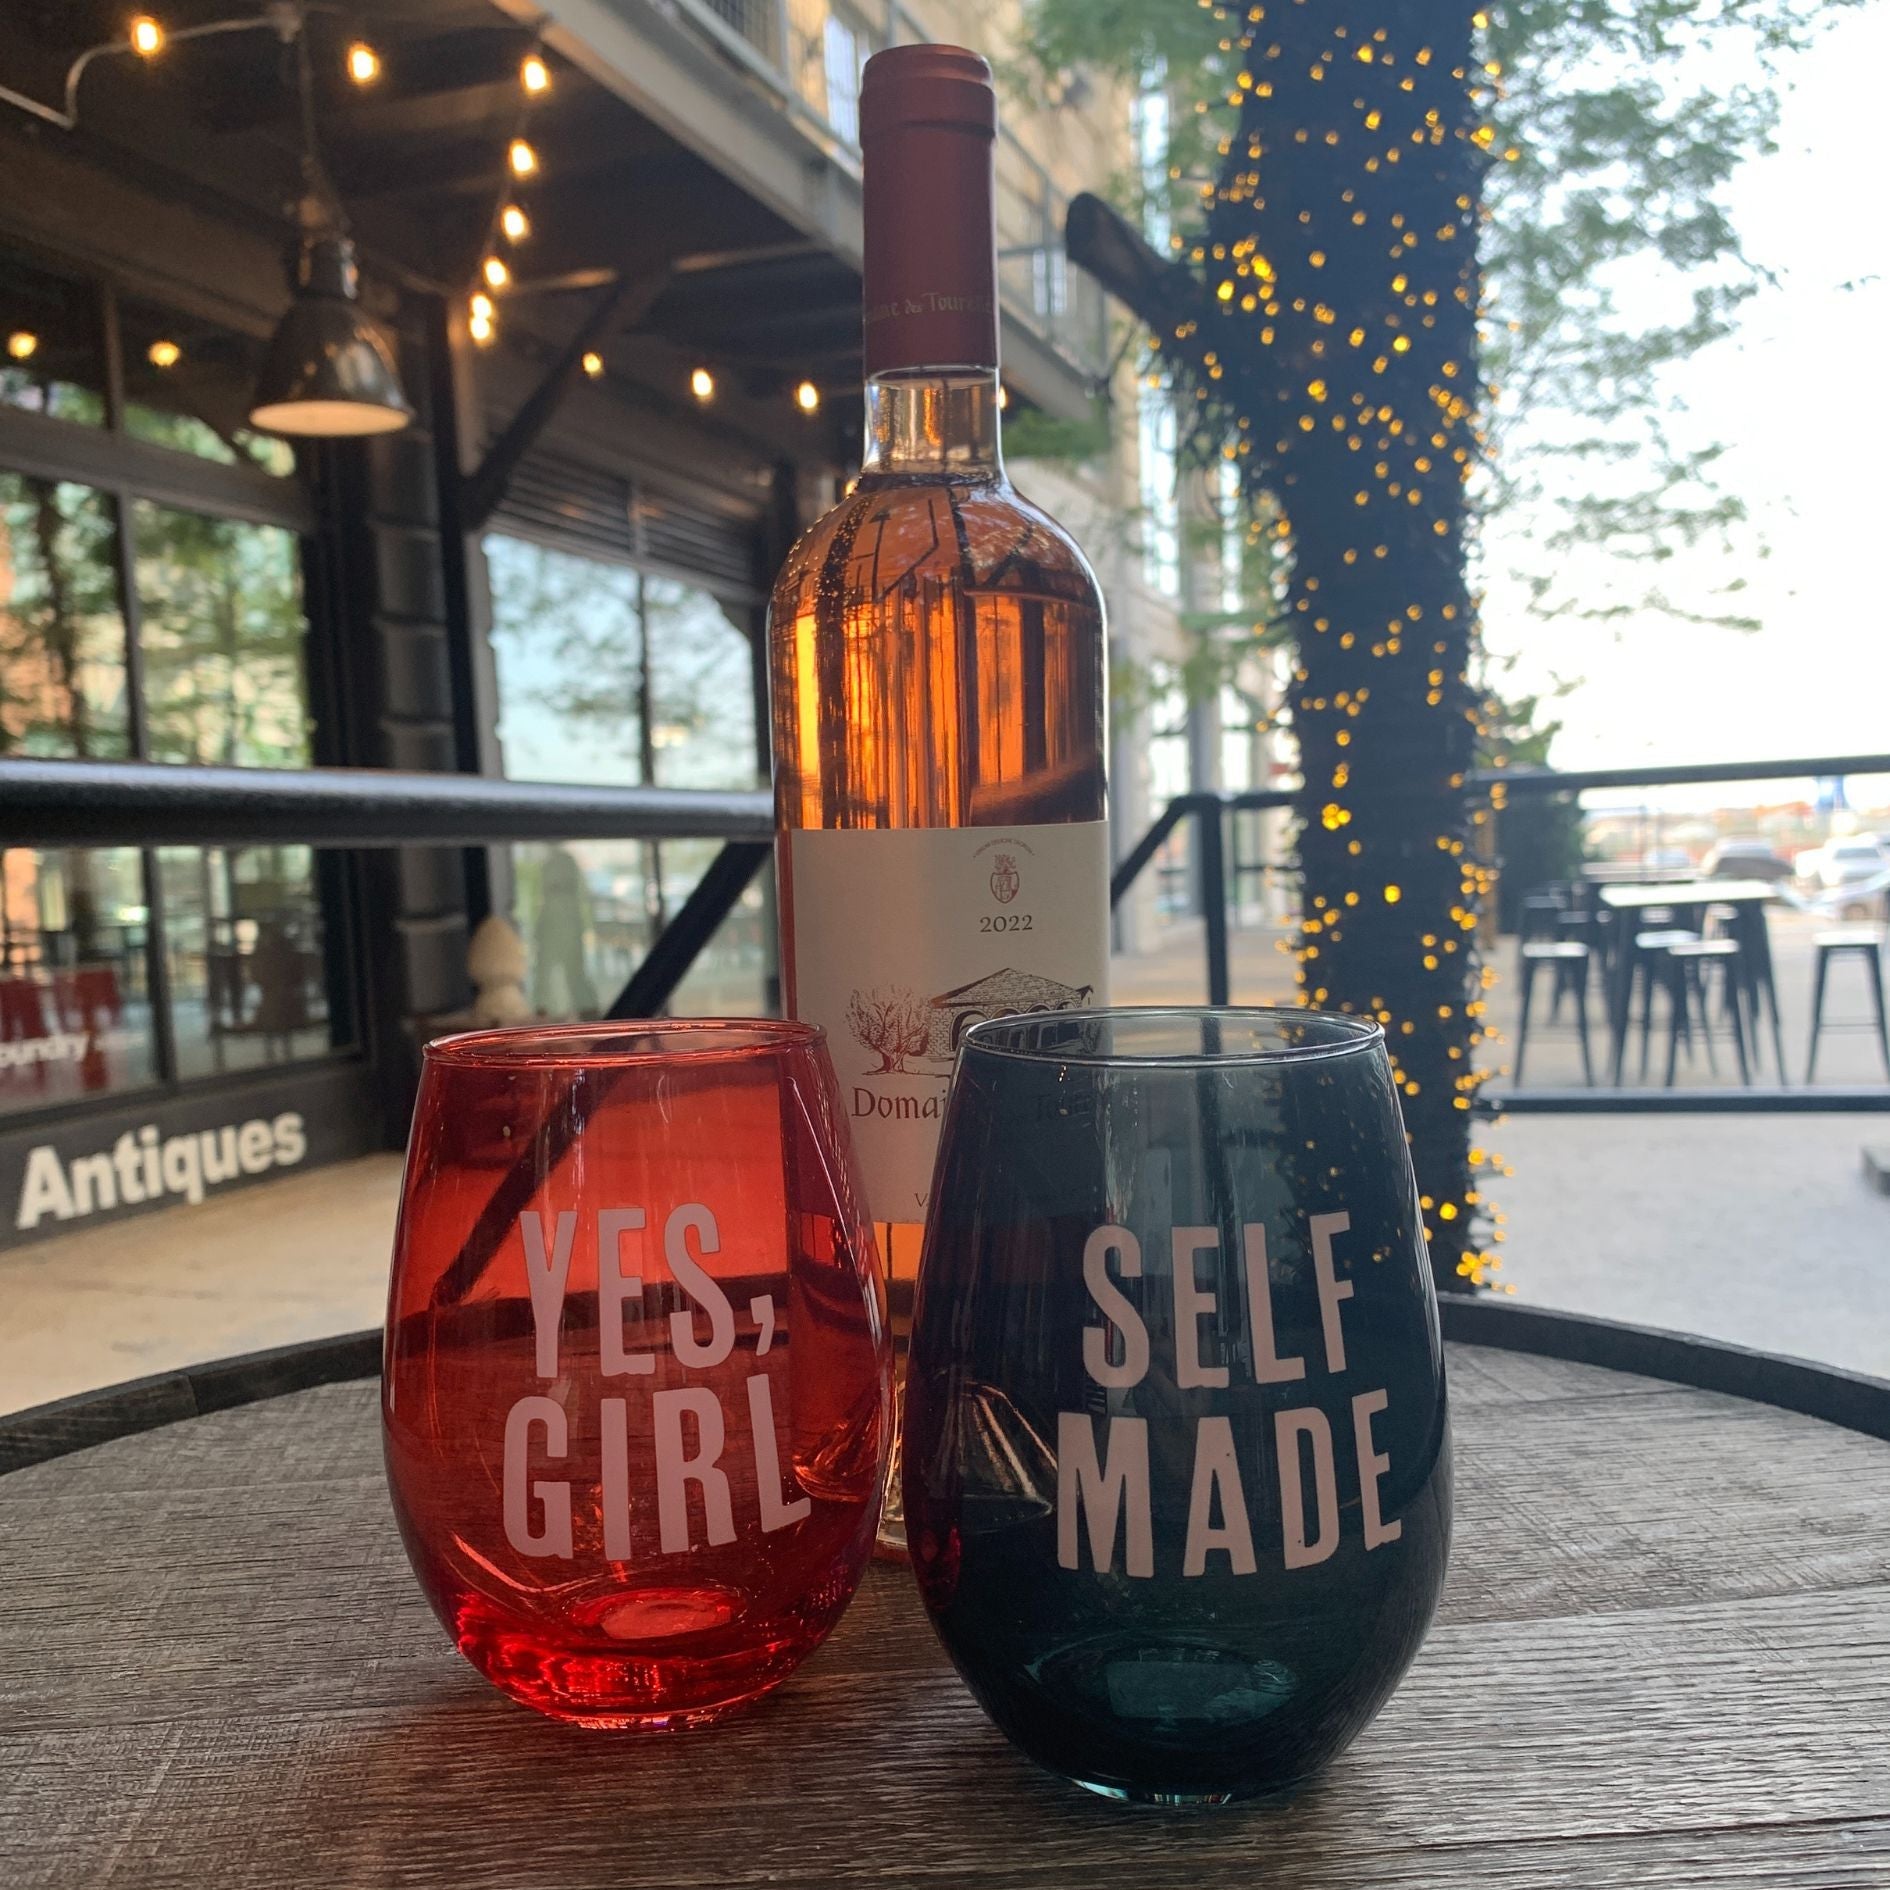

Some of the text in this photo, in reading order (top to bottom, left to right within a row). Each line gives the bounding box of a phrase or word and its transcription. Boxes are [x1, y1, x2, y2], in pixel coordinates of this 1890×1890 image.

[980, 914, 1032, 932] 2022
[16, 1110, 307, 1230] Antiques
[519, 1202, 775, 1378] YES,
[1082, 1210, 1354, 1389] SELF
[503, 1373, 811, 1561] GIRL
[1057, 1388, 1401, 1578] MADE
